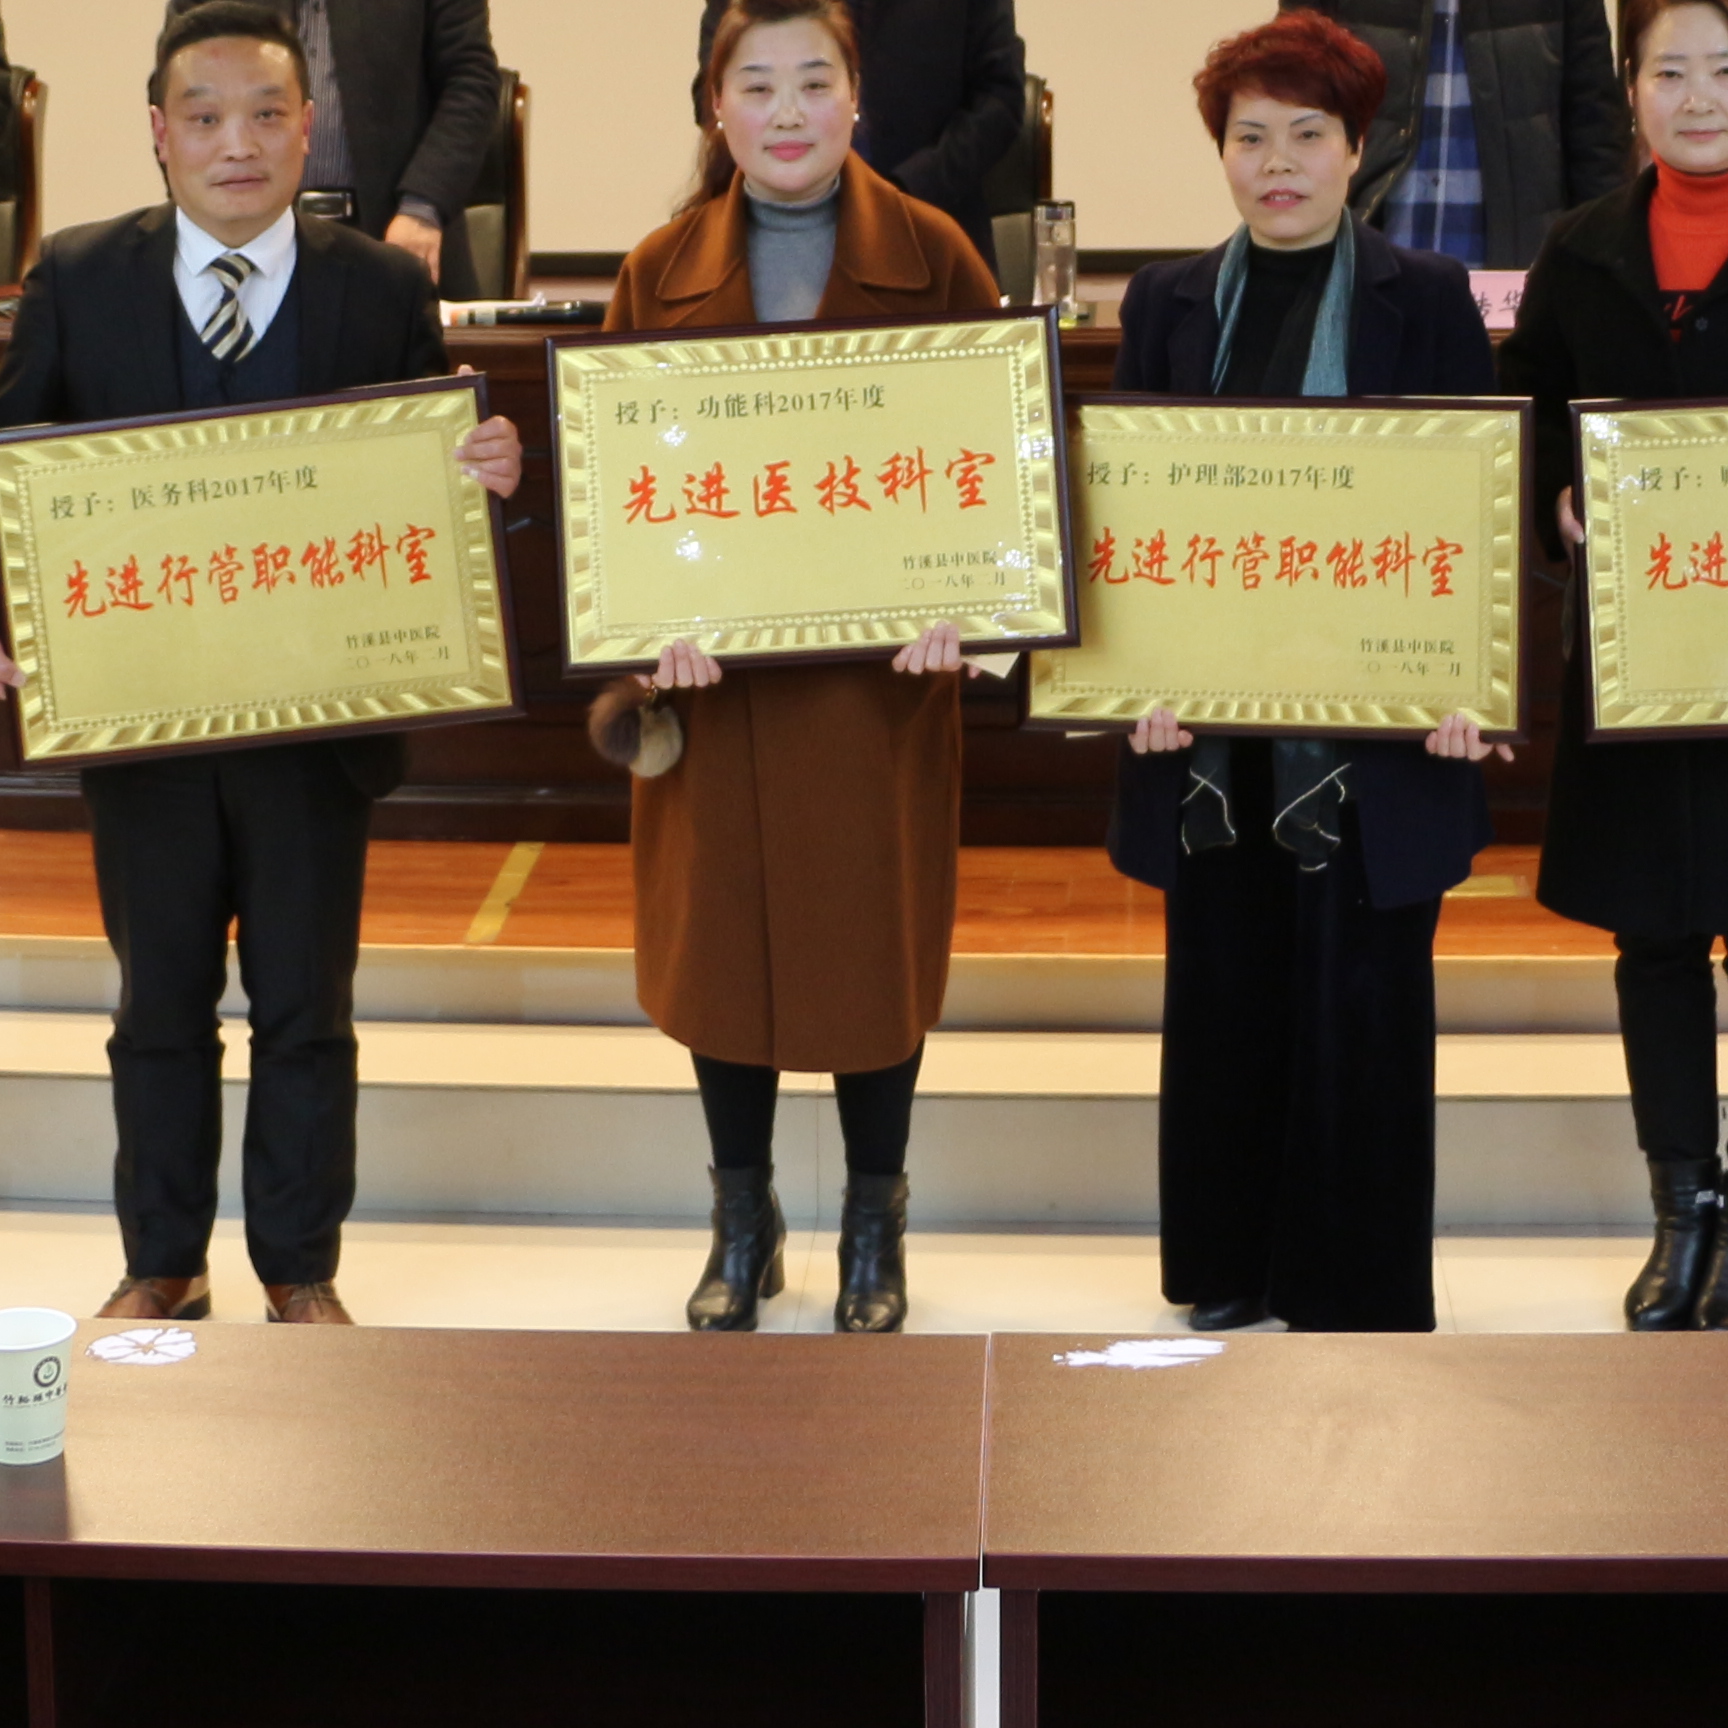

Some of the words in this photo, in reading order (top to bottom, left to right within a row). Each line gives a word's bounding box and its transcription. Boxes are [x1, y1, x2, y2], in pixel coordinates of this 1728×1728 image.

[622, 446, 997, 525] 先进医技科室
[62, 522, 438, 619] 先进行管职能科室
[1087, 526, 1465, 598] 先进行管职能科室
